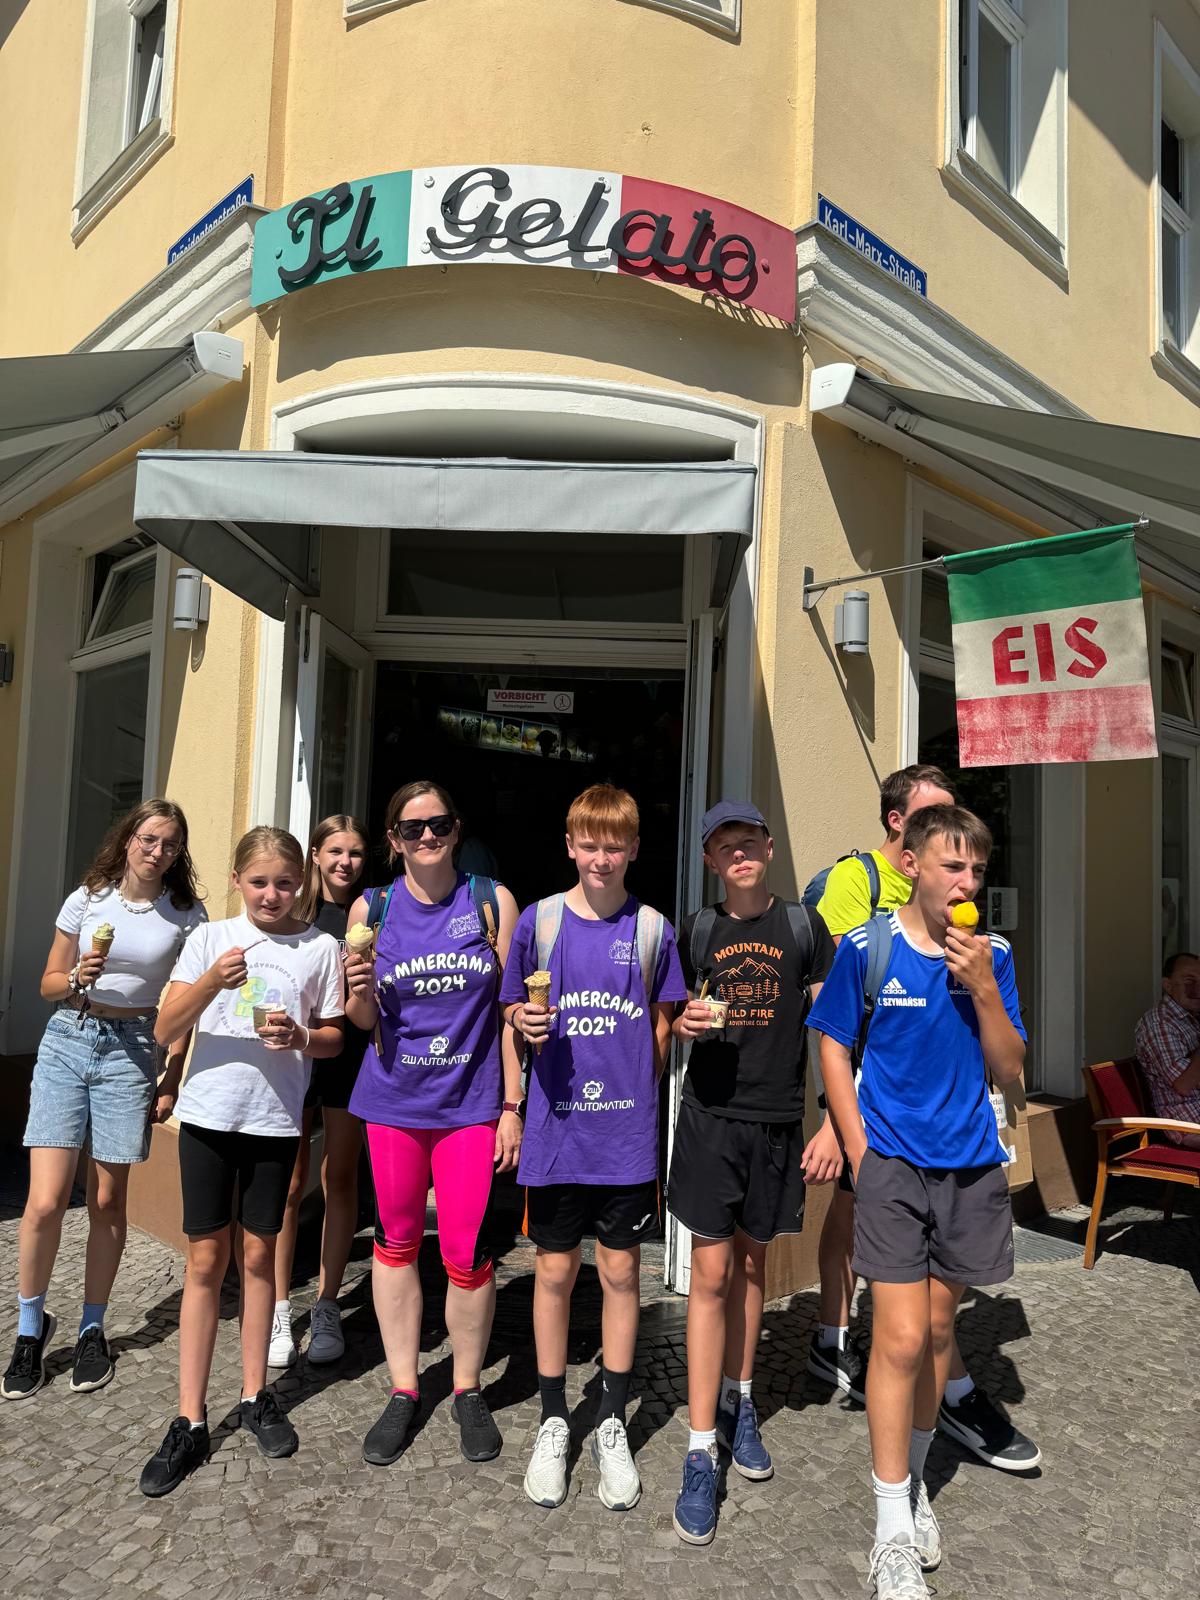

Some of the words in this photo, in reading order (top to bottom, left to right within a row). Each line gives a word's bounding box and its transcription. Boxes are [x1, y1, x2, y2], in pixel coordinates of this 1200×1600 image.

[278, 181, 380, 282] Il
[426, 167, 757, 281] Gelato
[824, 205, 922, 291] Karl-Marx-Straße
[992, 617, 1107, 686] EIS
[494, 691, 546, 701] VORSICHT
[714, 943, 783, 962] MOUNTAIN
[414, 974, 467, 996] 2024
[558, 990, 643, 1020] MMERCAMP
[883, 996, 927, 1007] SZYMAŃSKI
[728, 1009, 746, 1018] ILD
[750, 1009, 775, 1018] FIRE
[566, 1015, 617, 1036] 2024
[573, 1099, 634, 1111] AUTOMATION
